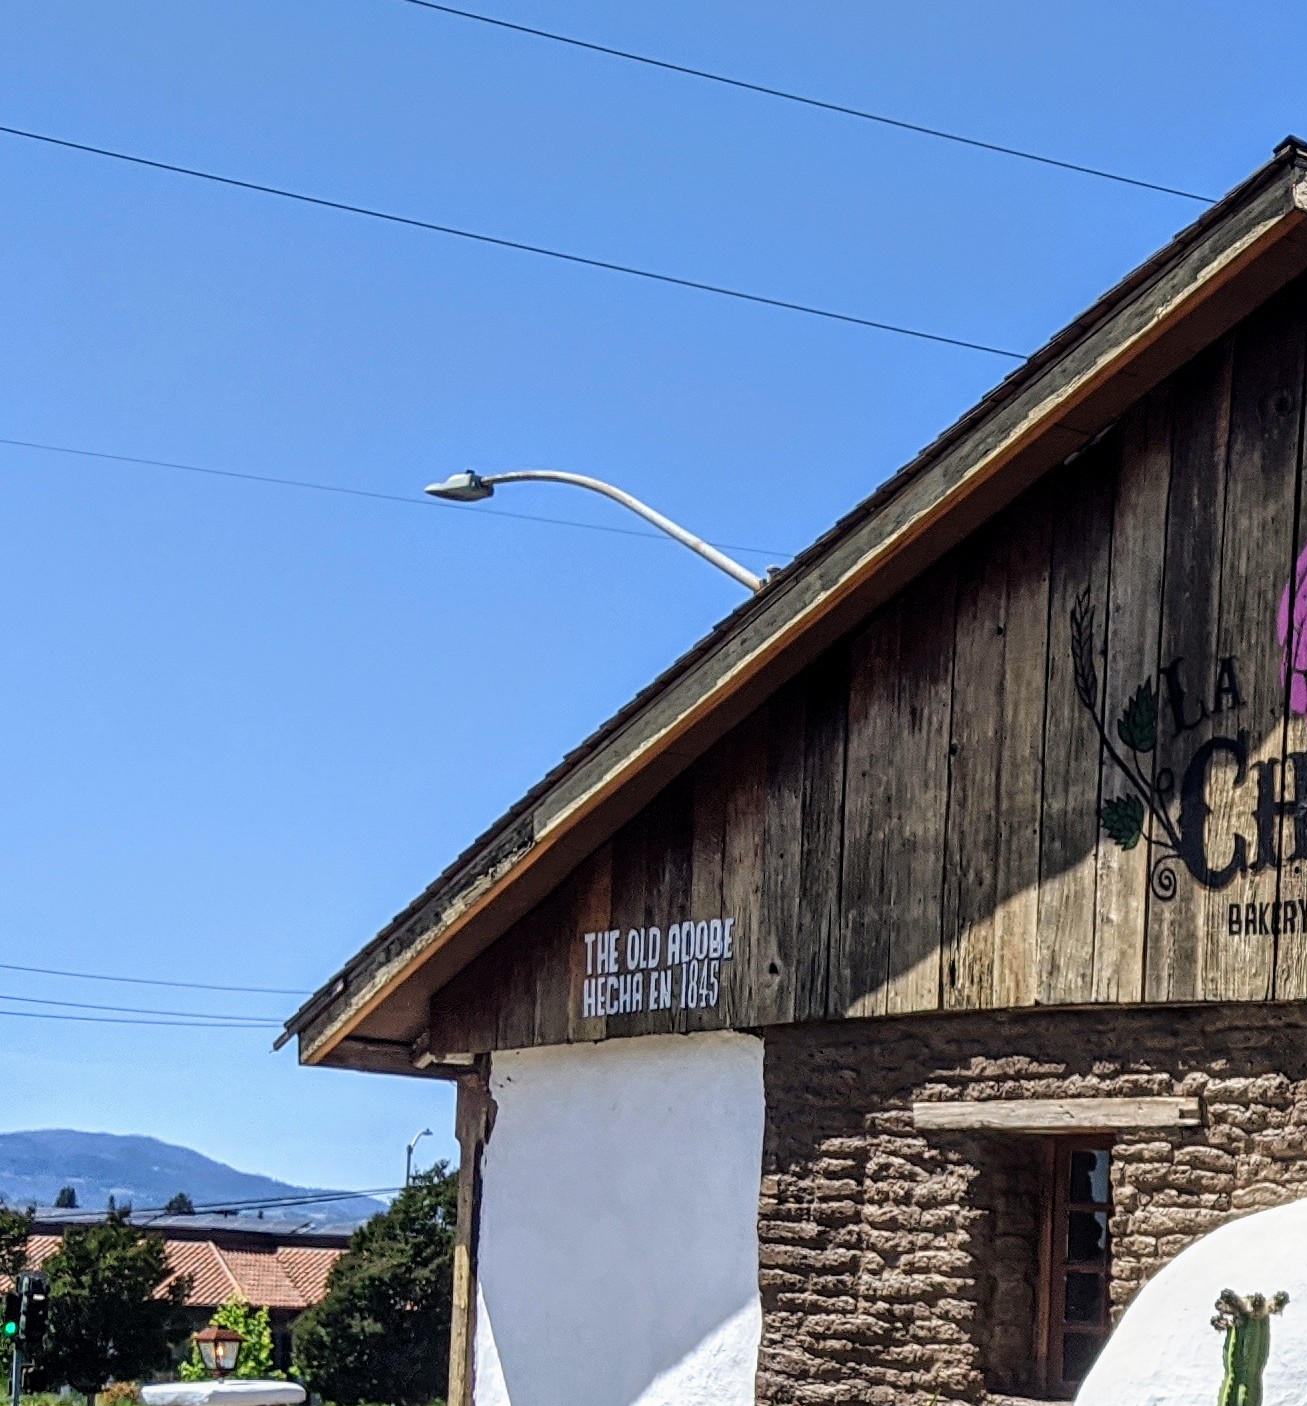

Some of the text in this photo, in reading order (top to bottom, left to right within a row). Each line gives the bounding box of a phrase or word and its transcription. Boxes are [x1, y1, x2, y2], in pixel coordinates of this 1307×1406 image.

[1159, 656, 1247, 738] LA
[584, 917, 735, 976] THE OLD ADOBE
[583, 959, 720, 1018] HECHA EN 1845
